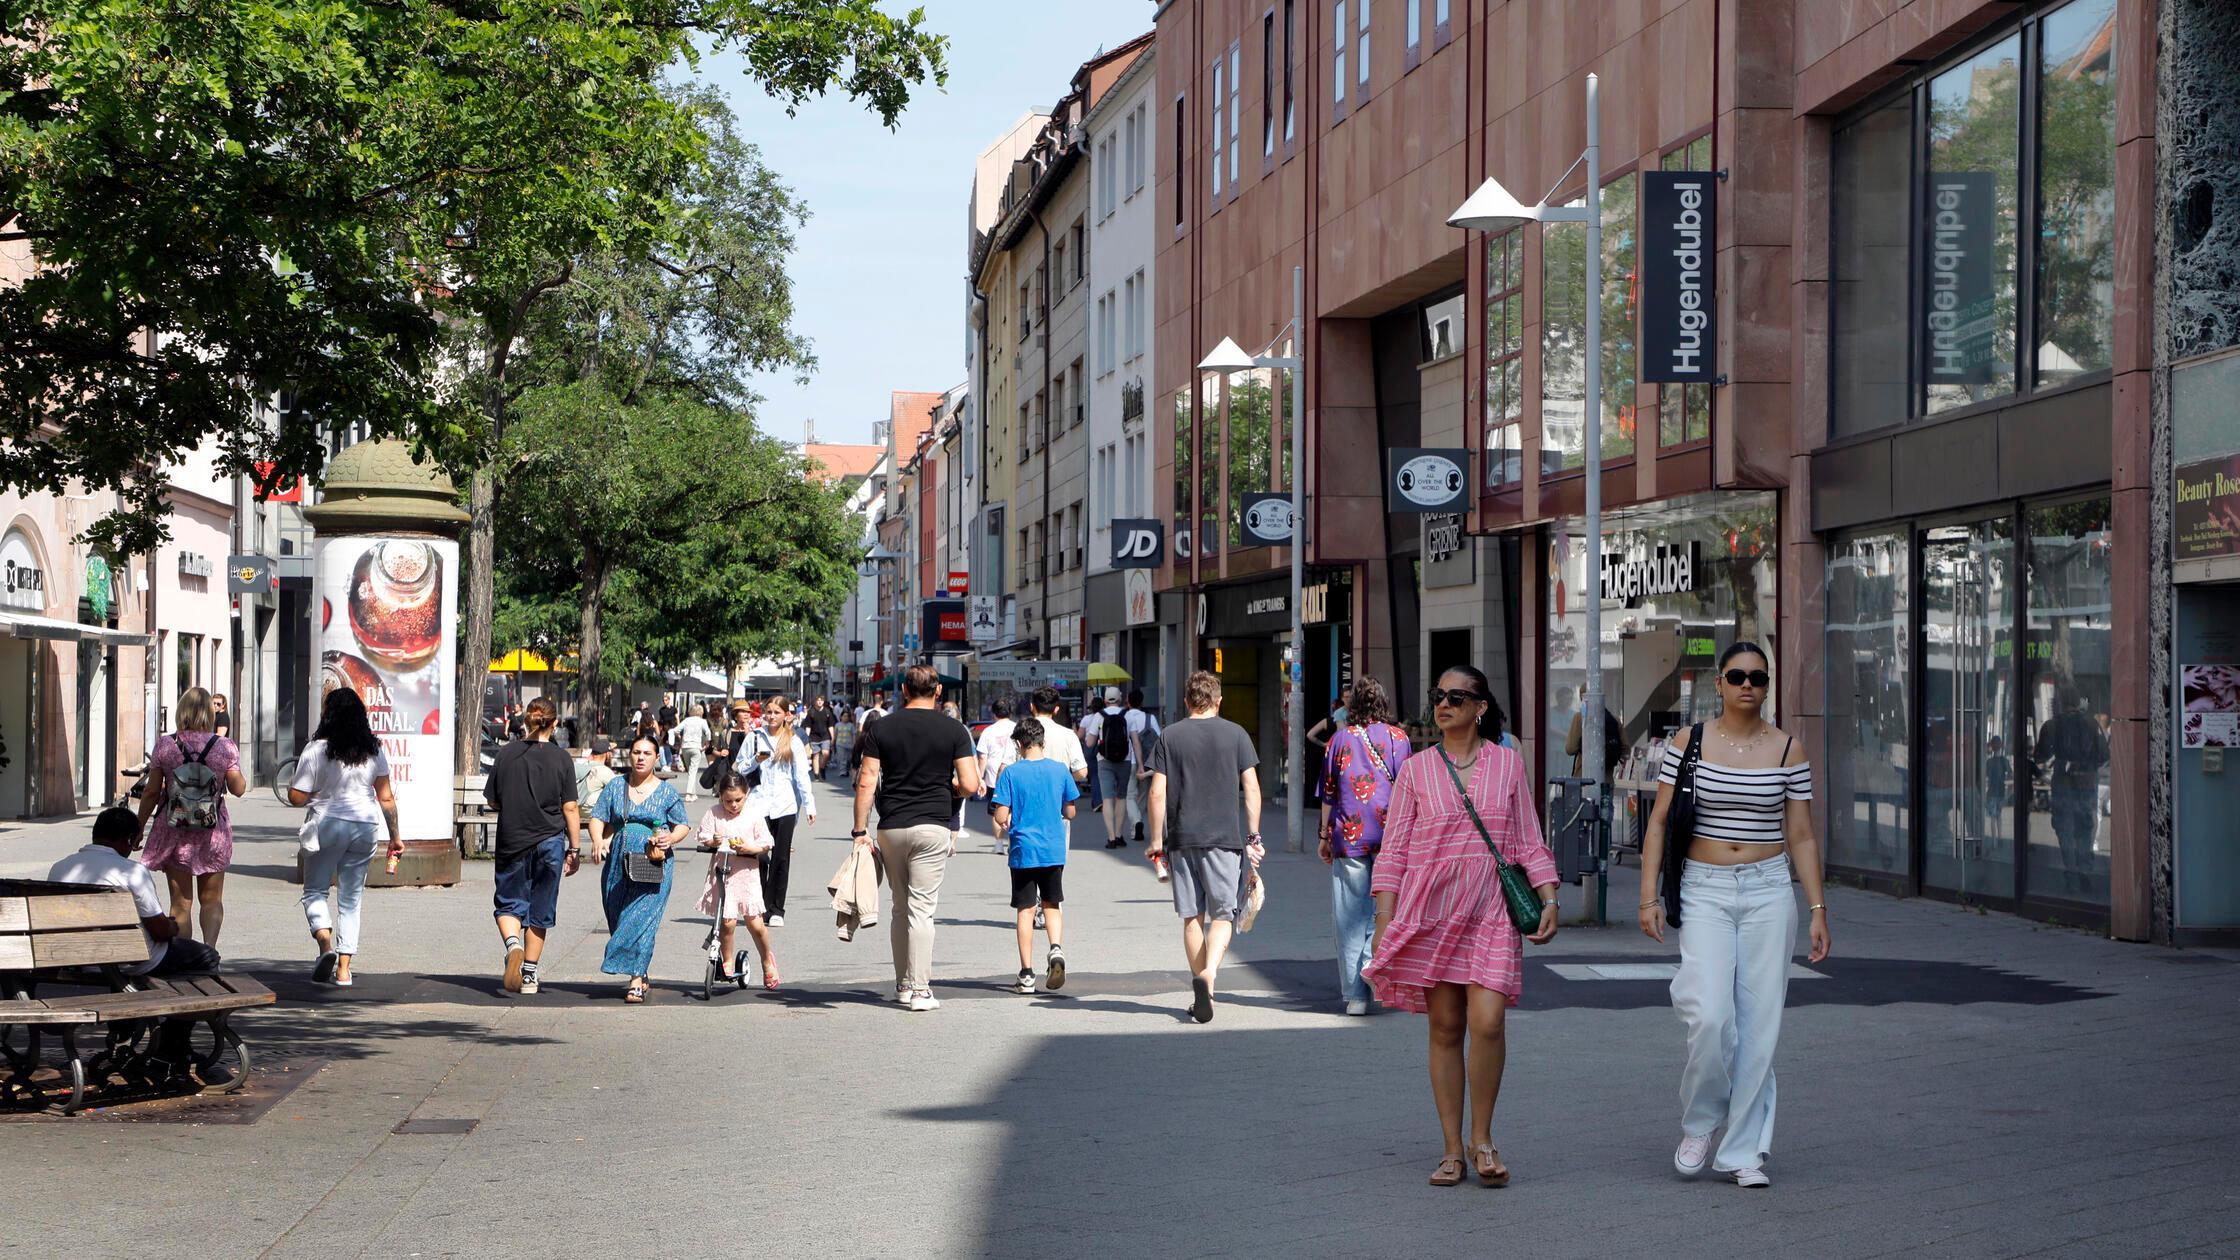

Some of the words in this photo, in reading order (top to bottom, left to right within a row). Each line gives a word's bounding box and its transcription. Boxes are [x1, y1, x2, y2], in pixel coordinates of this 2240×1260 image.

[1672, 183, 1707, 373] Hugendubel
[2177, 480, 2213, 506] Beauty
[1117, 530, 1157, 558] JD
[1429, 525, 1459, 563] GRENE
[949, 578, 967, 586] LEGO
[941, 621, 965, 629] HEMA
[365, 686, 394, 706] DAS
[368, 711, 415, 732] GINAL.
